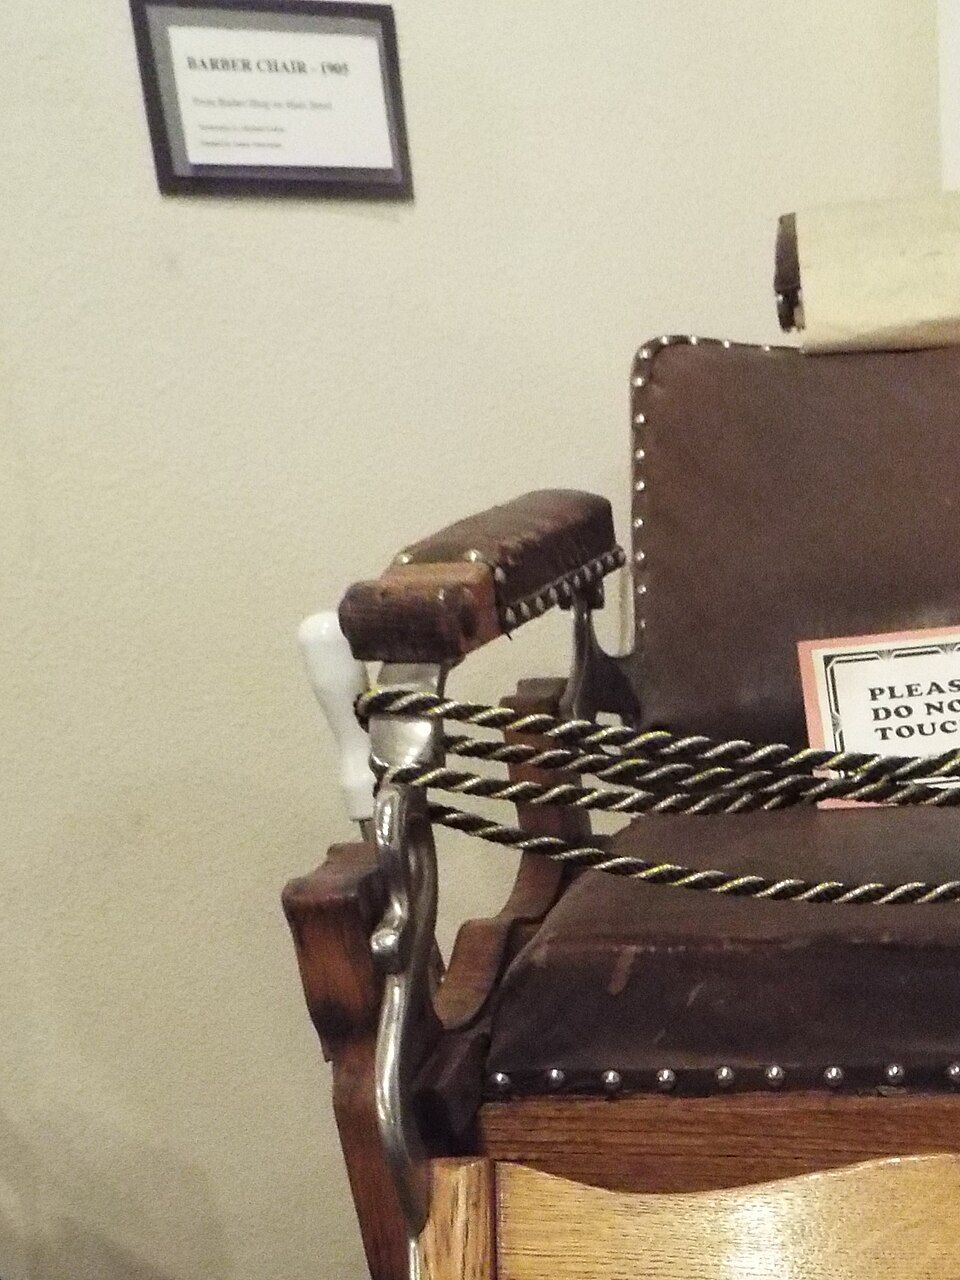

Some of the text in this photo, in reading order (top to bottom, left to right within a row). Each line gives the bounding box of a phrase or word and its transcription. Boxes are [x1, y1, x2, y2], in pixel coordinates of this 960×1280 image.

[187, 56, 252, 72] BARBER
[256, 58, 308, 74] CHAIR
[321, 62, 349, 76] 1905
[872, 705, 914, 722] DO
